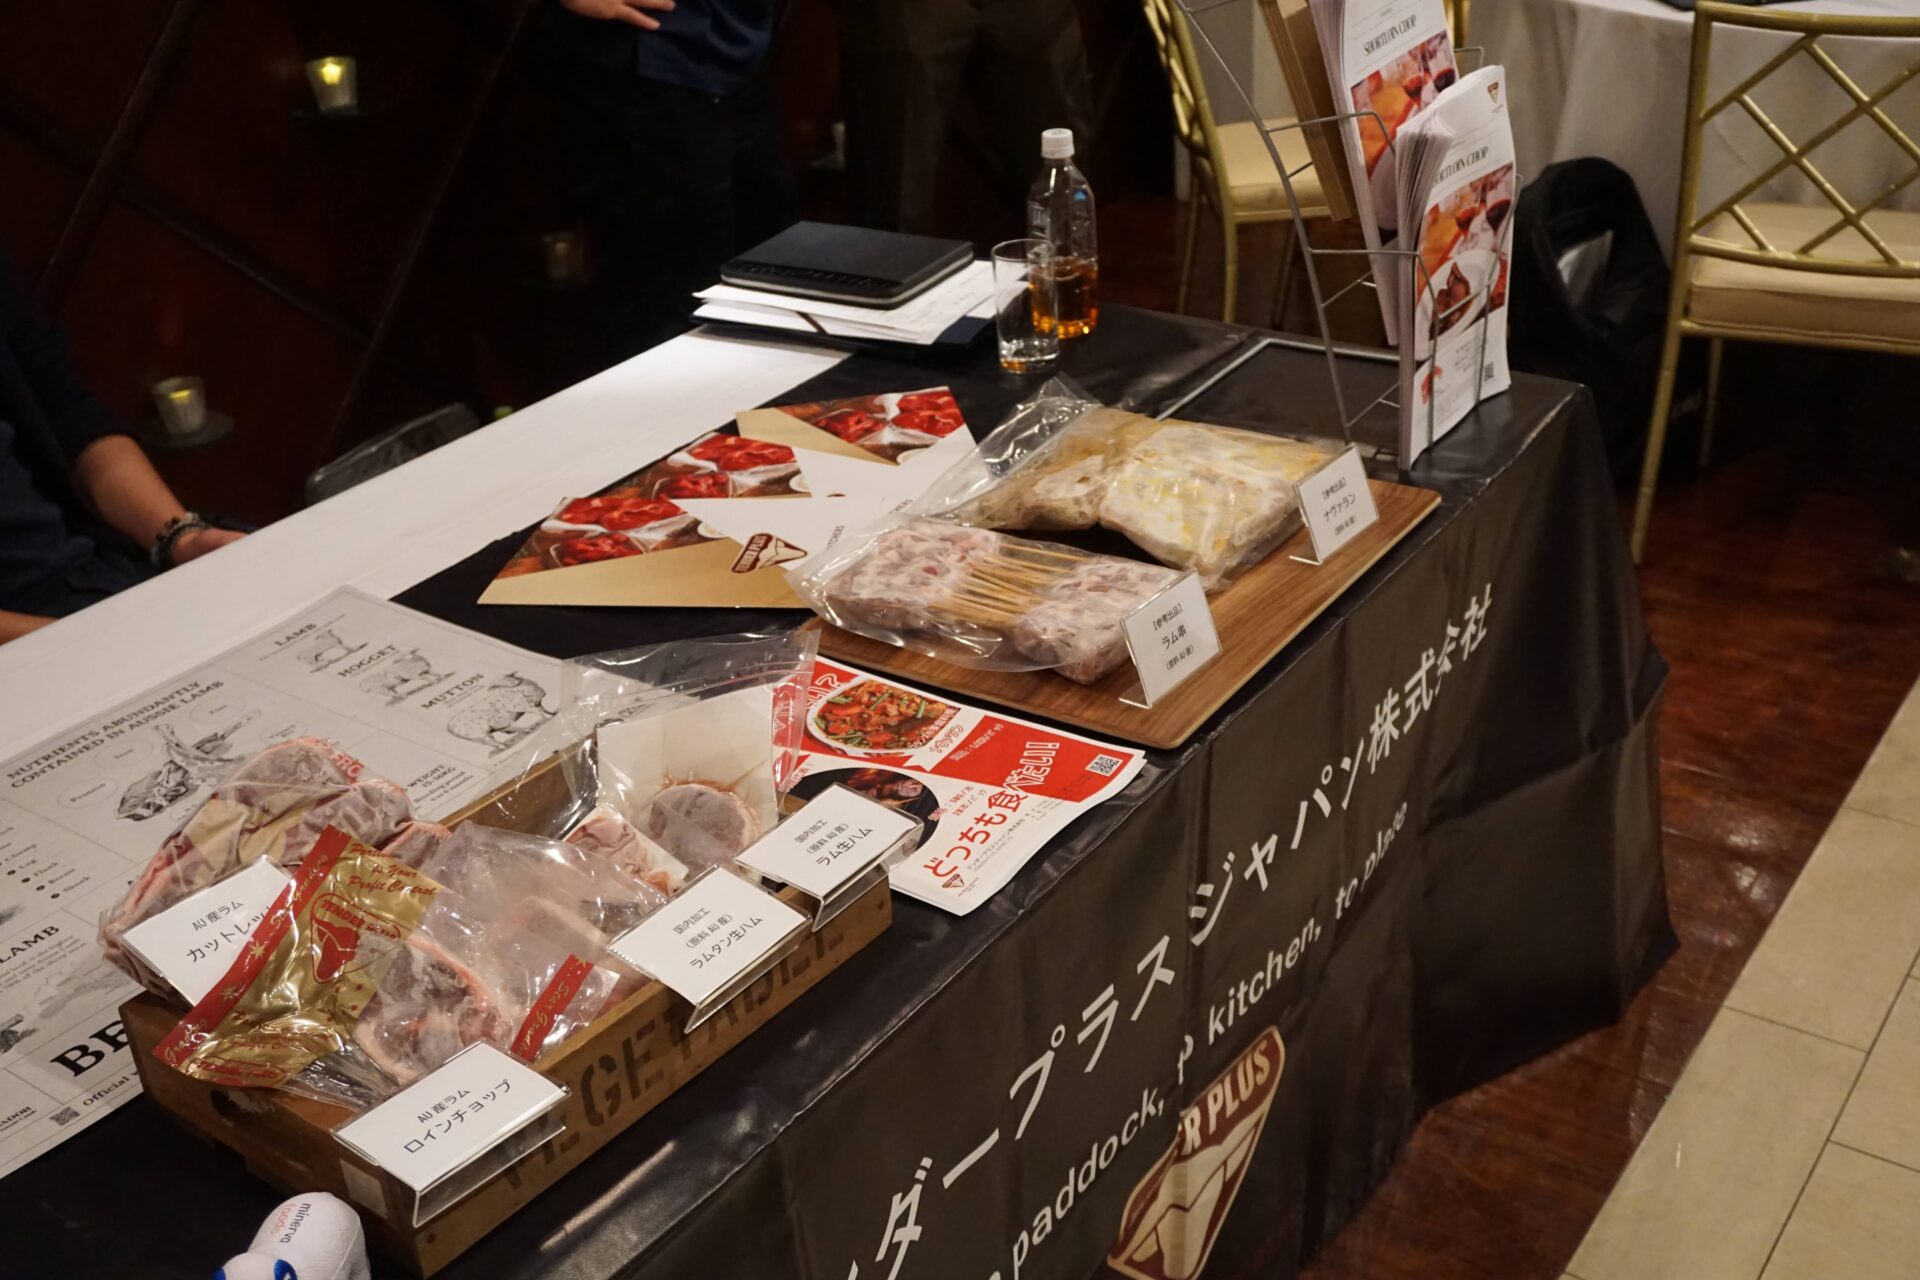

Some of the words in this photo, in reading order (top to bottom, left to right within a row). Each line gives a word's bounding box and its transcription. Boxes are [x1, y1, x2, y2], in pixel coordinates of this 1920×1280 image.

[275, 623, 317, 646] LAMB
[1162, 624, 1187, 649] ラム串
[338, 644, 397, 677] HOGGET
[421, 673, 485, 710] MUTTON
[7, 731, 100, 780] NUTRIENTS
[103, 681, 200, 734] ABUNDANTLY
[11, 737, 105, 789] CONTAINED
[106, 728, 126, 741] IN
[130, 699, 181, 731] AUSSIE
[181, 680, 224, 705] LAMB
[795, 818, 828, 844] 国内加工
[815, 825, 874, 867] ラム生ハム
[826, 829, 837, 841] AU
[348, 875, 386, 894] Profit
[387, 879, 438, 897] Control
[387, 864, 419, 878] Your
[191, 919, 207, 932] AU
[206, 900, 244, 925] 産ラム
[672, 906, 710, 936] 国内加工
[707, 920, 719, 934] AU
[848, 583, 1494, 1280] ダープラスジャパン株式会社
[689, 916, 763, 969] ラムタン生ハム
[83, 1075, 131, 1107] Official
[1011, 1086, 1166, 1280] paddock,
[1208, 915, 1322, 1046] kitchen,
[1335, 876, 1360, 920] to
[1207, 1039, 1271, 1136] PLUS
[403, 1078, 512, 1155] ロインチョップ
[416, 1110, 433, 1124] AU
[431, 1088, 472, 1115] 産ラム
[280, 1202, 312, 1244] minerva
